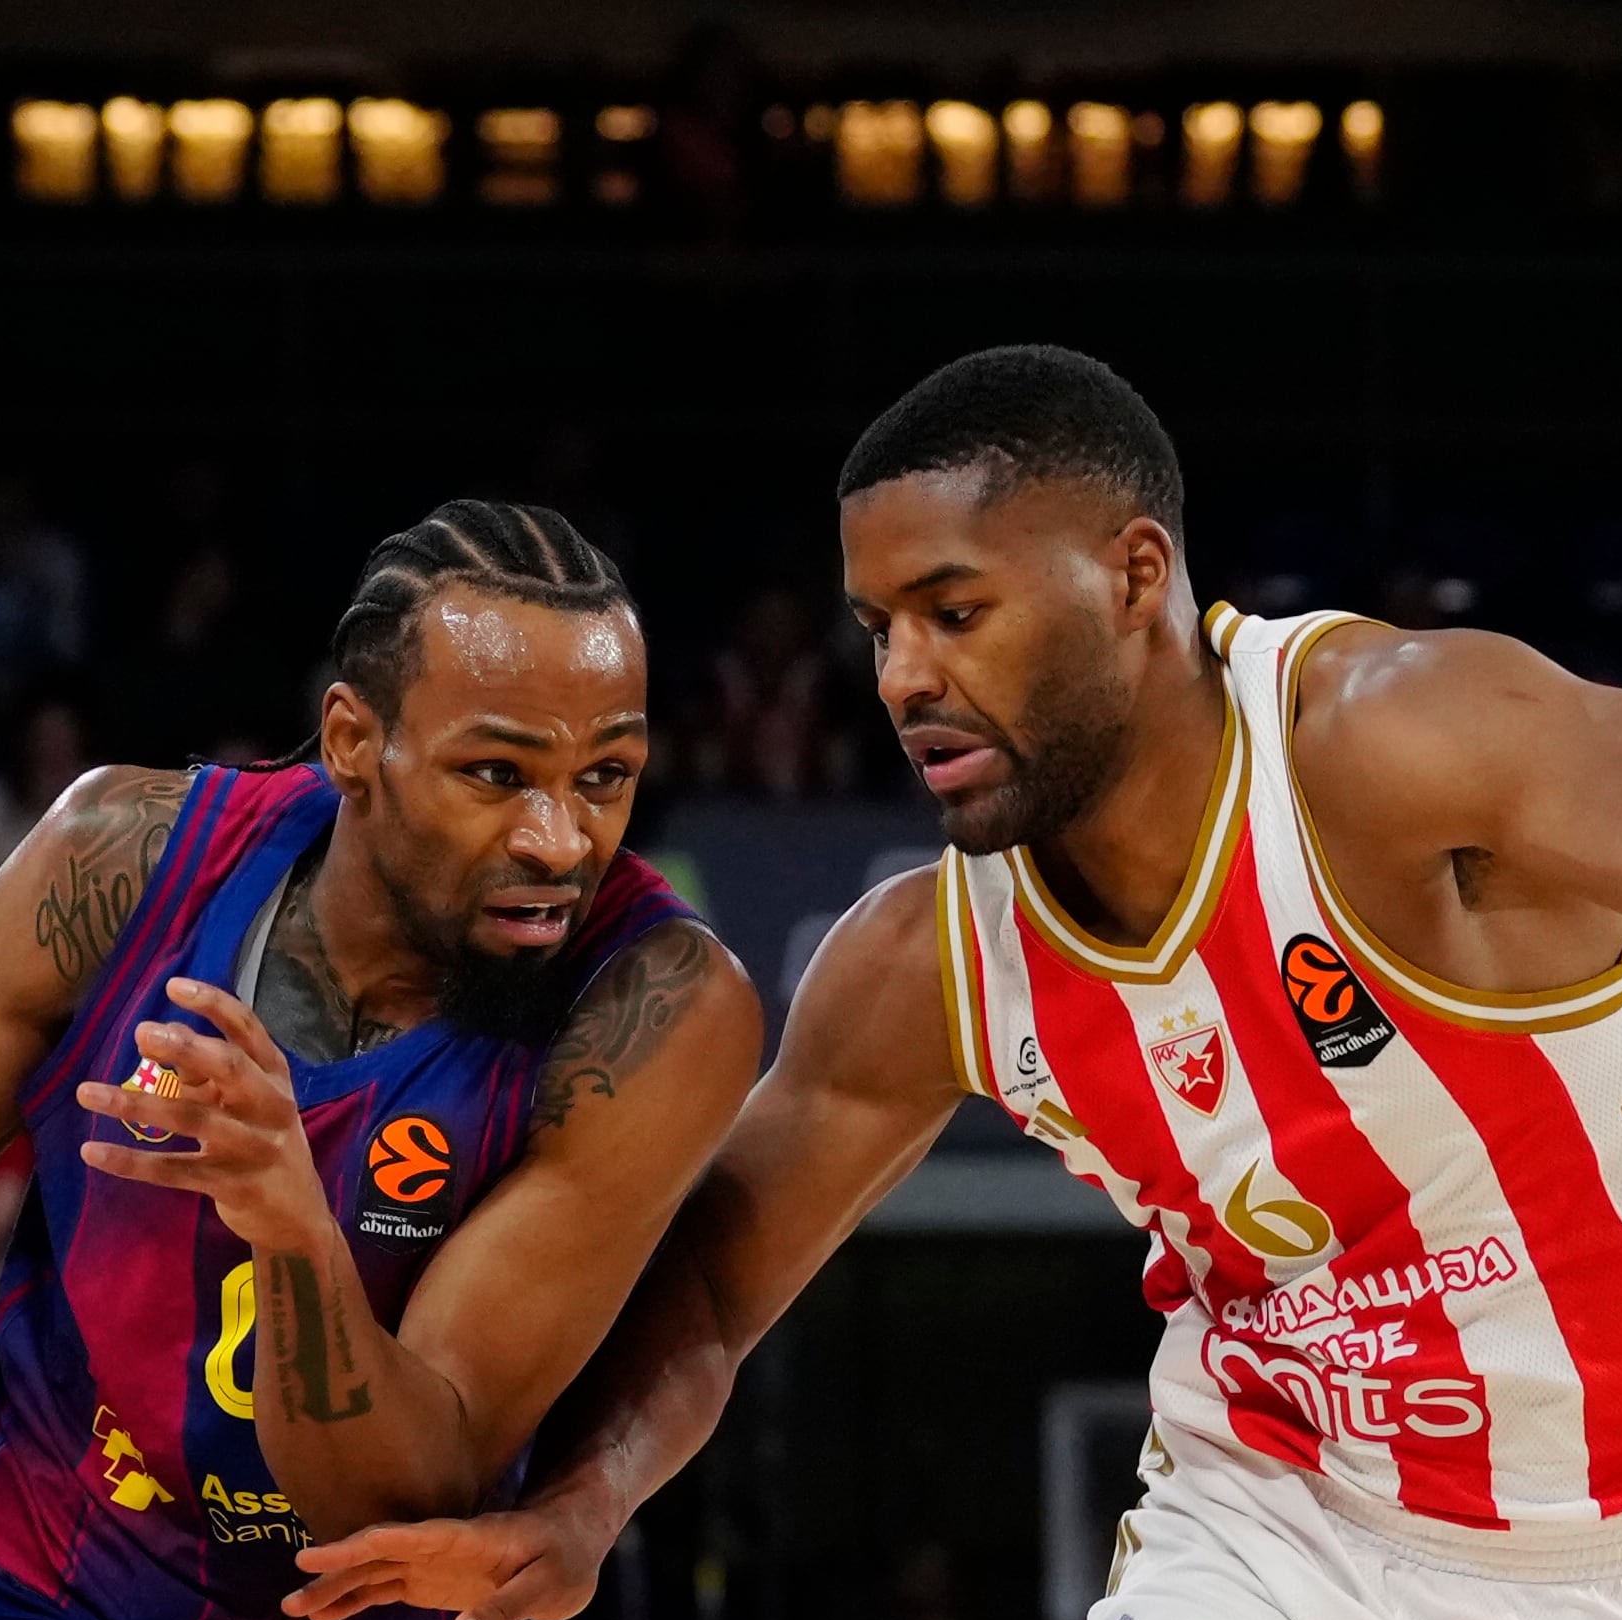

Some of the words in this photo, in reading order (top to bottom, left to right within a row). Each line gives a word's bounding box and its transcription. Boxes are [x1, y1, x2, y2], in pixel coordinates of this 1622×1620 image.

[1320, 1043, 1348, 1062] abu
[1346, 1022, 1390, 1052] dhabi
[1224, 1156, 1331, 1257] 6
[360, 1219, 393, 1236] abu
[395, 1223, 444, 1238] dhabi
[1204, 1331, 1485, 1439] mts
[208, 1507, 314, 1550] Sanit
